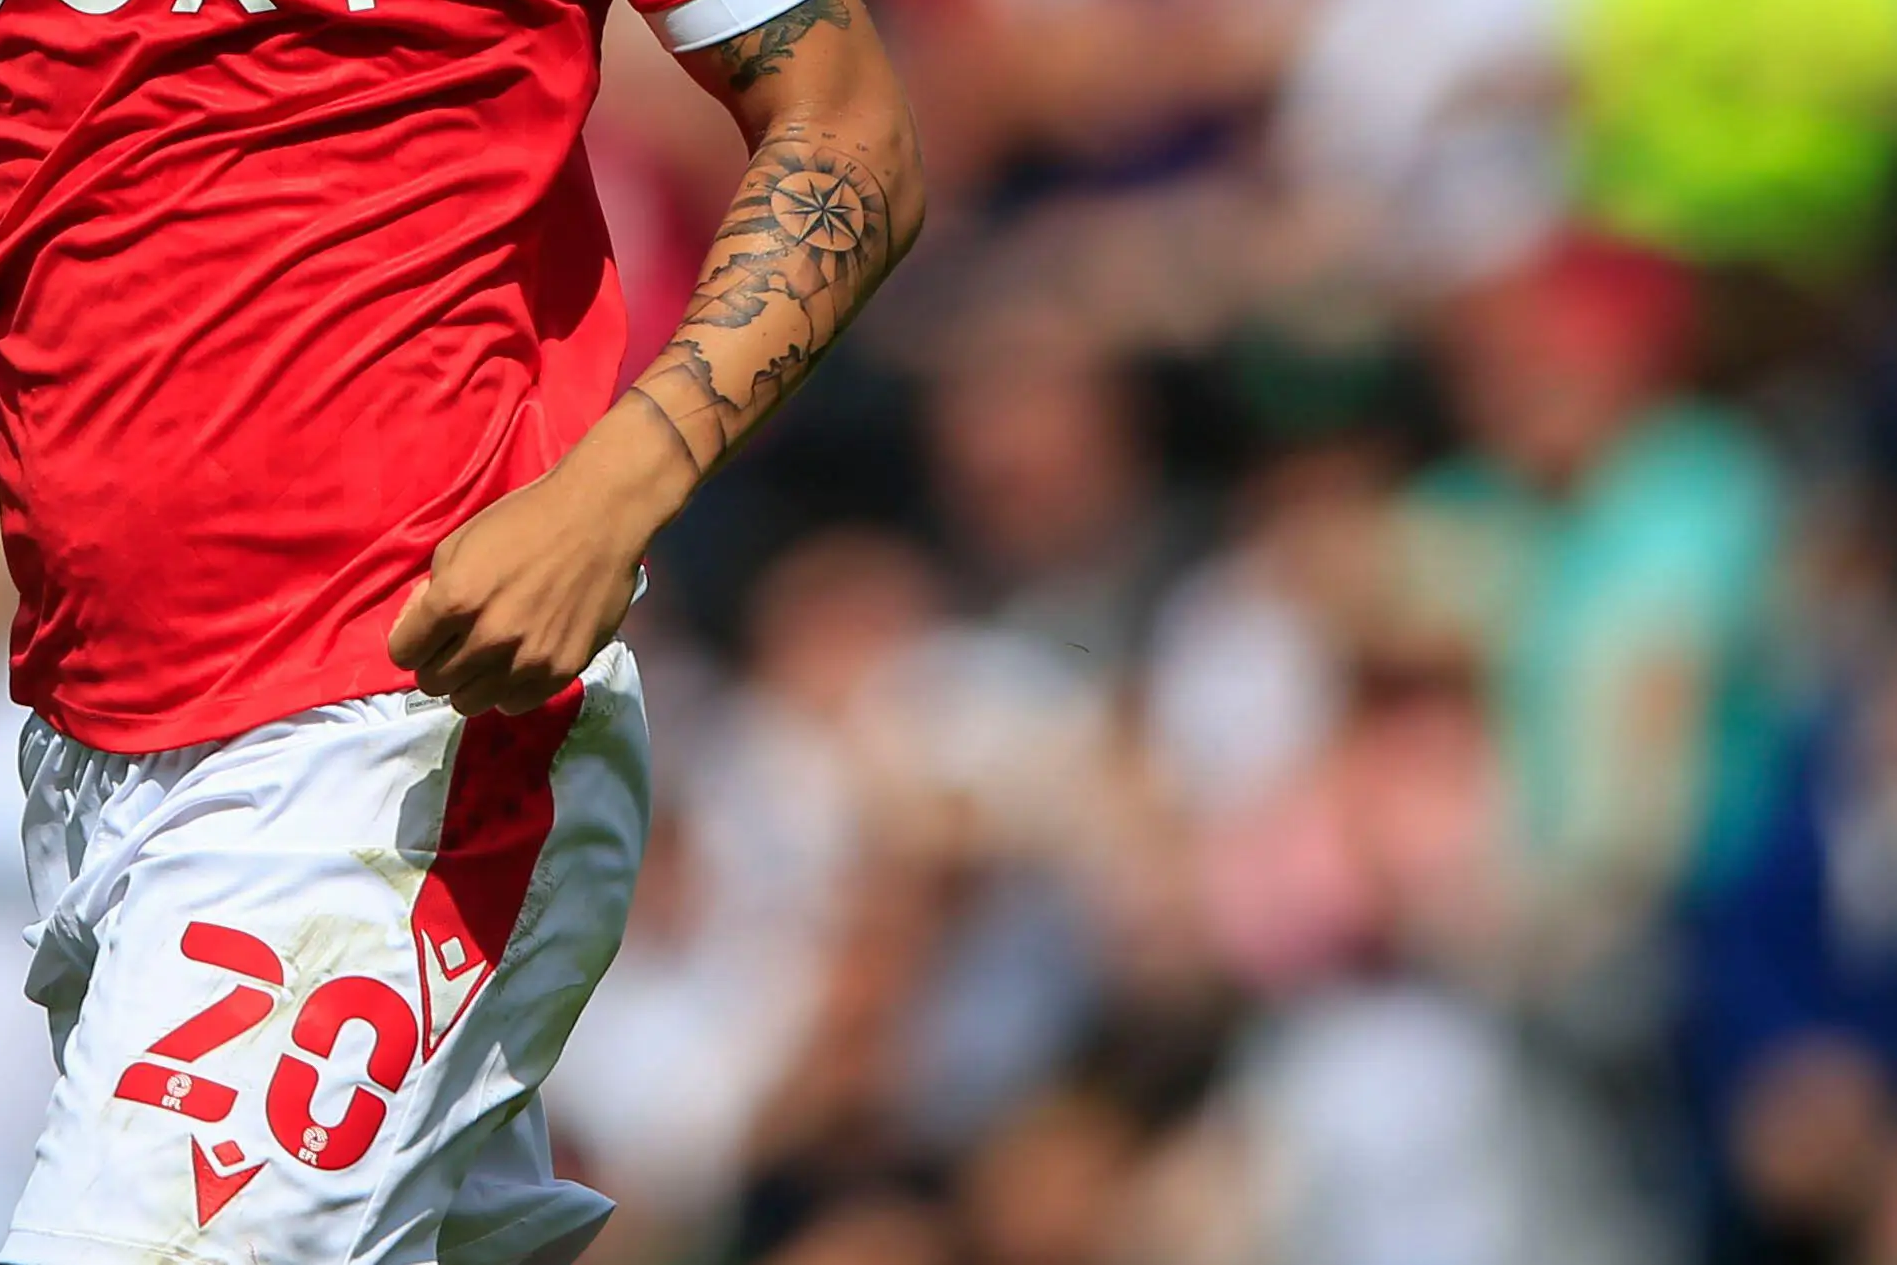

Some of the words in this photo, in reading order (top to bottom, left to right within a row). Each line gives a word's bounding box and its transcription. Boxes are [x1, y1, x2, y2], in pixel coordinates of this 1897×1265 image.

[113, 920, 419, 1172] 20
[161, 1094, 182, 1111] EFL
[298, 1147, 318, 1166] EFL
